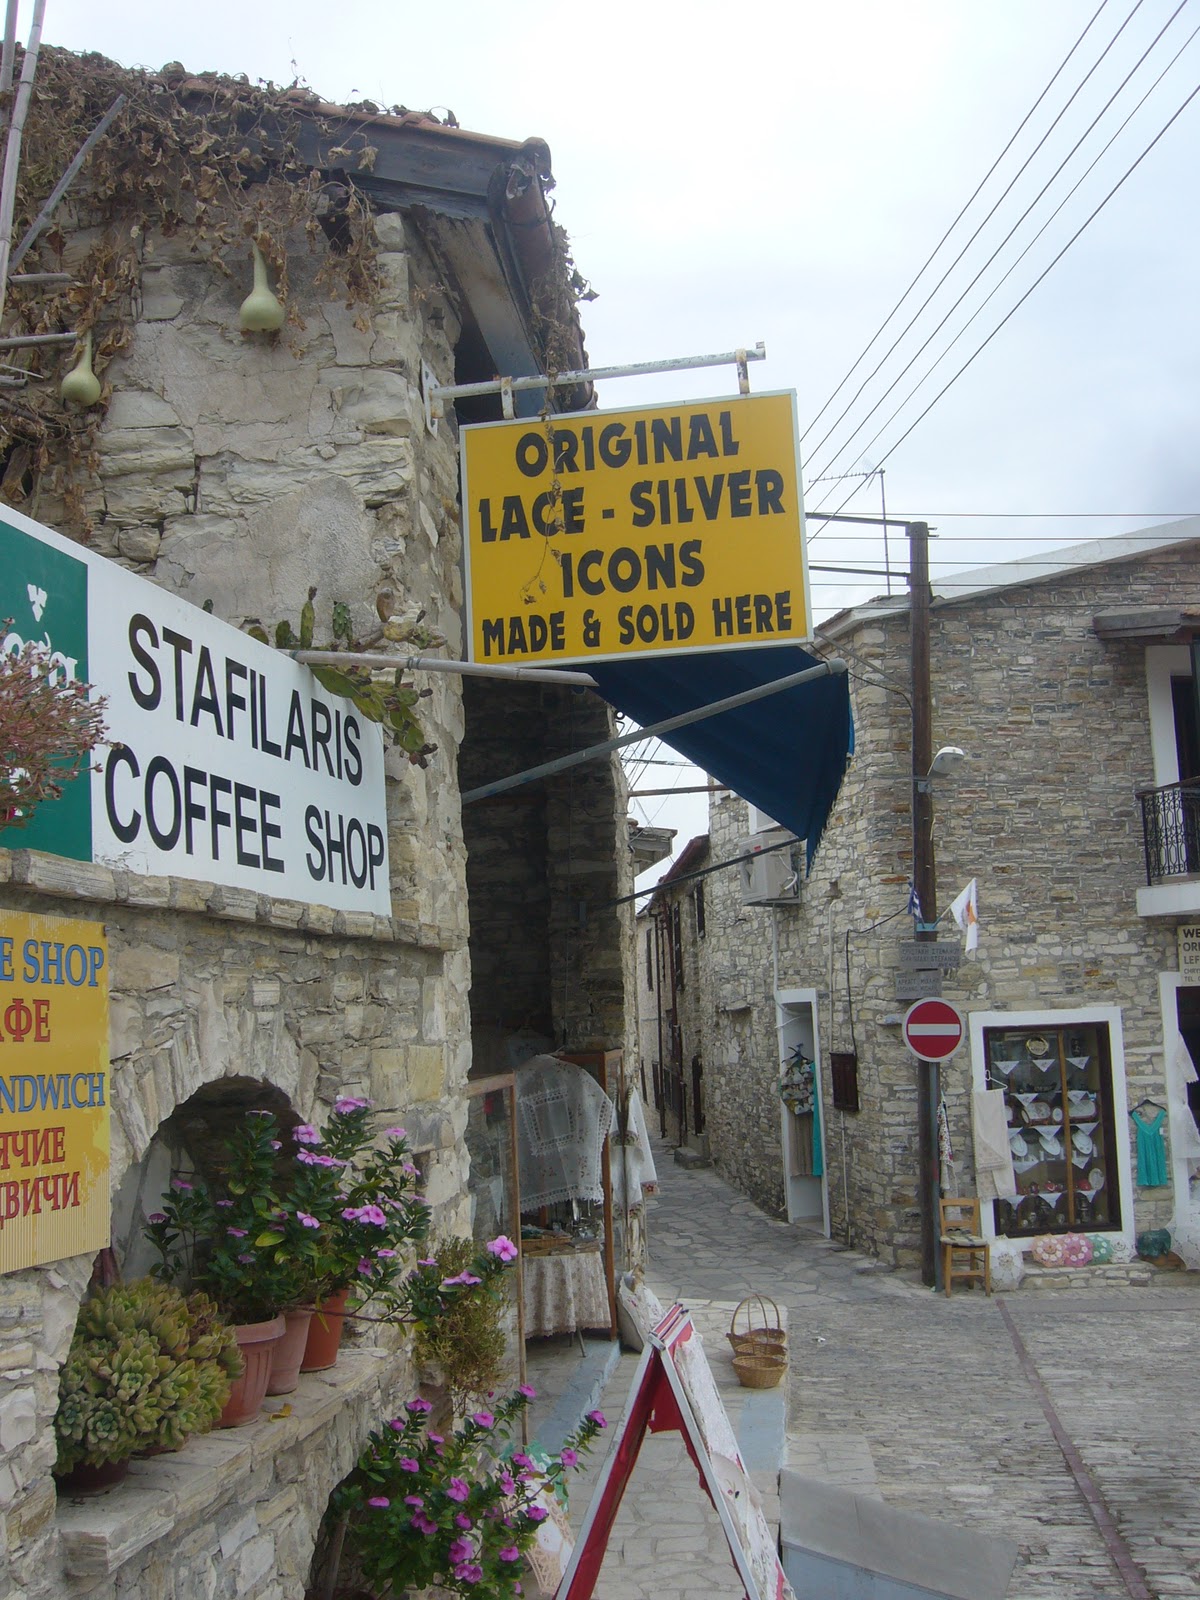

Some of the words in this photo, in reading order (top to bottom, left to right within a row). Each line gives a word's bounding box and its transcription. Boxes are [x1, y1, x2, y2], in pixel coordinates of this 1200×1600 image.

[515, 411, 739, 477] ORIGINAL
[478, 487, 586, 543] LACE
[629, 468, 786, 527] SILVER
[561, 539, 705, 598] ICONS
[482, 611, 565, 657] MADE
[582, 609, 601, 647] &
[617, 601, 695, 646] SOLD
[712, 590, 793, 637] HERE
[128, 613, 363, 786] STAFILARIS
[105, 744, 285, 874] COFFEE
[305, 804, 385, 890] SHOP
[23, 939, 104, 987] SHOP
